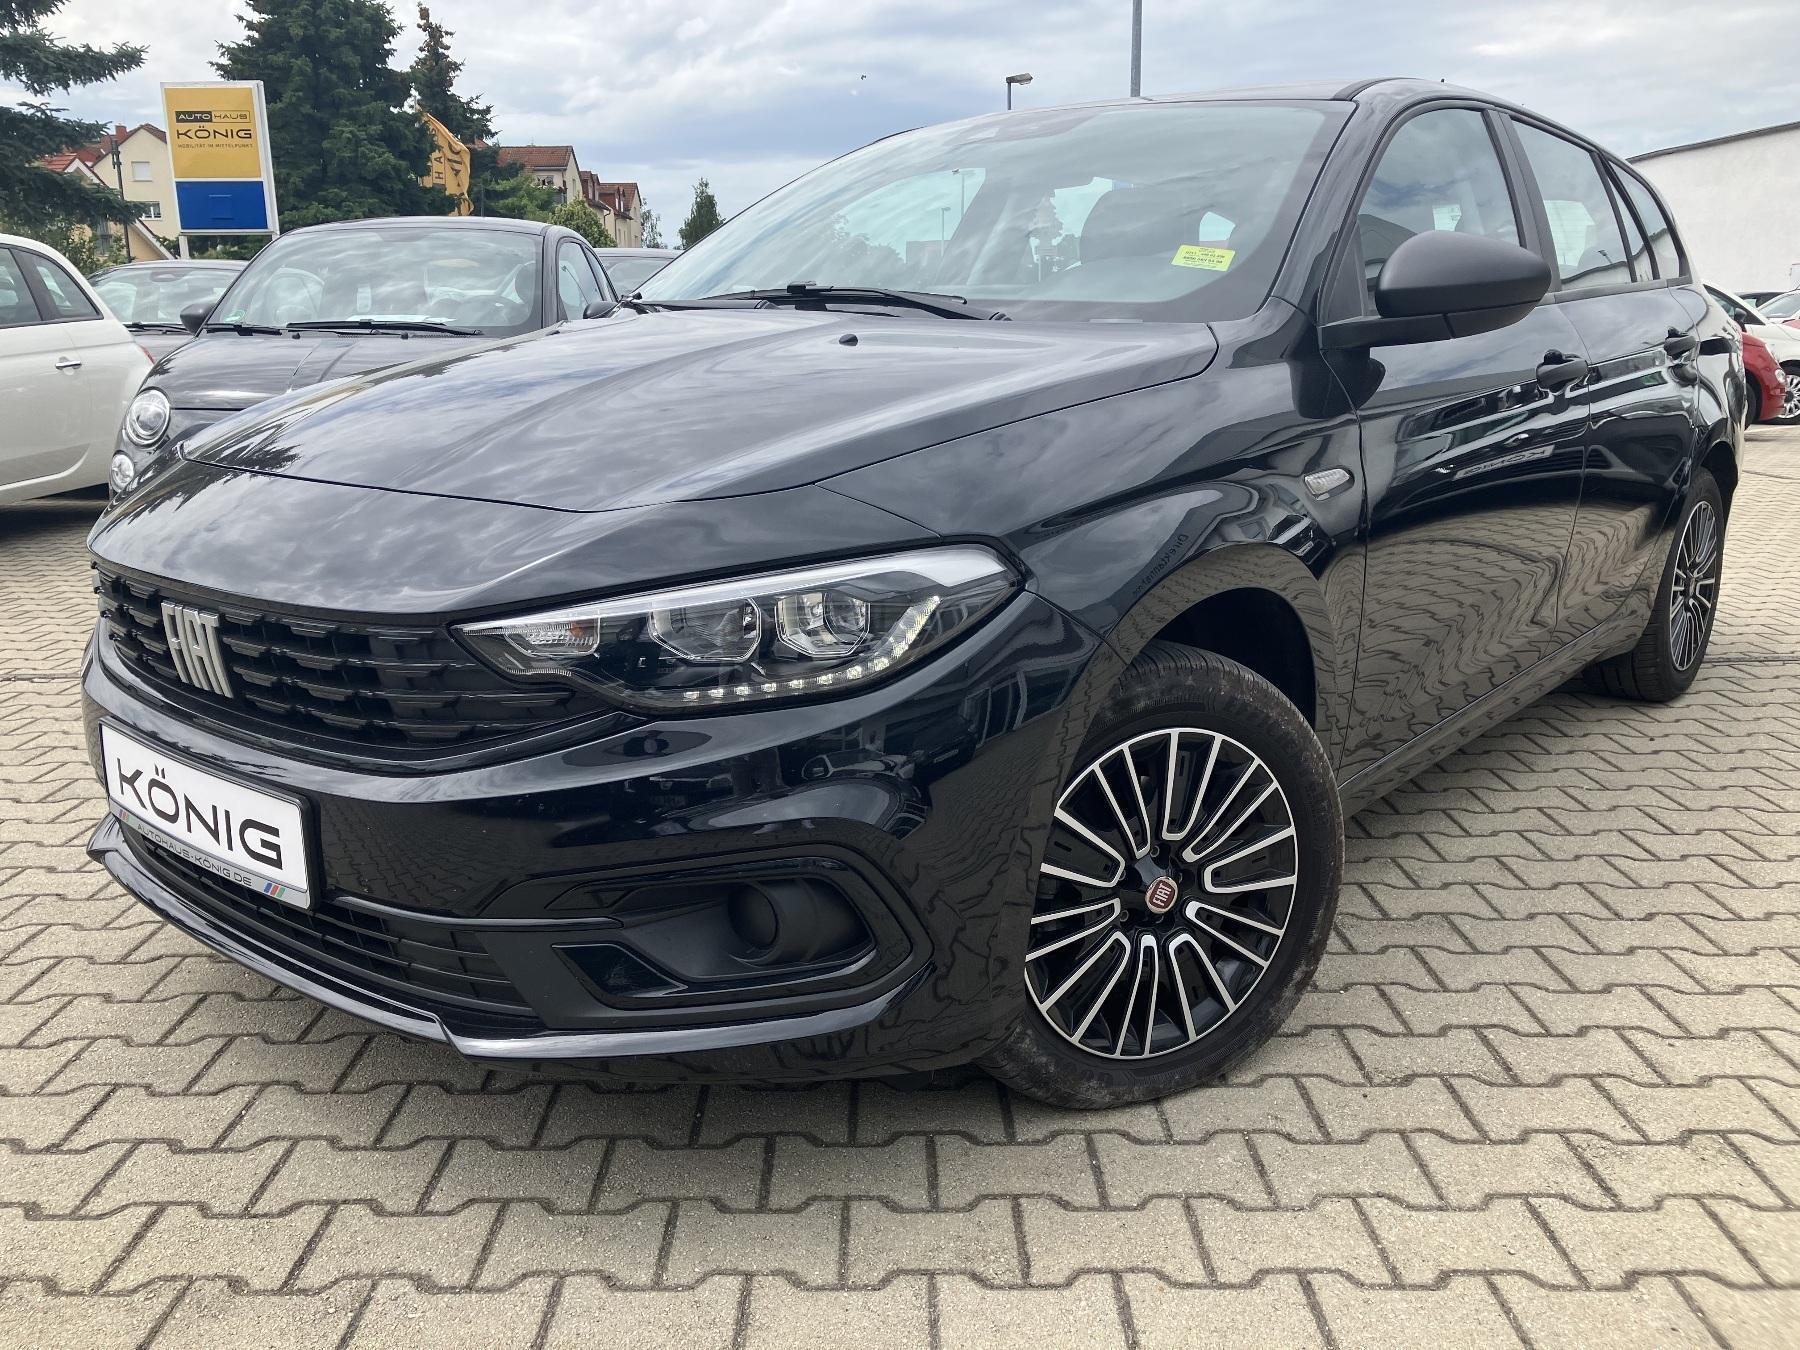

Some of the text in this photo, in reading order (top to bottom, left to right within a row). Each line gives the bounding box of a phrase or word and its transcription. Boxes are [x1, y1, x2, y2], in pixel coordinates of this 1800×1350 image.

[176, 125, 252, 139] KÖNIG
[160, 600, 234, 698] FIAT
[117, 757, 283, 870] KÖNIG
[1152, 882, 1172, 907] FIAT
